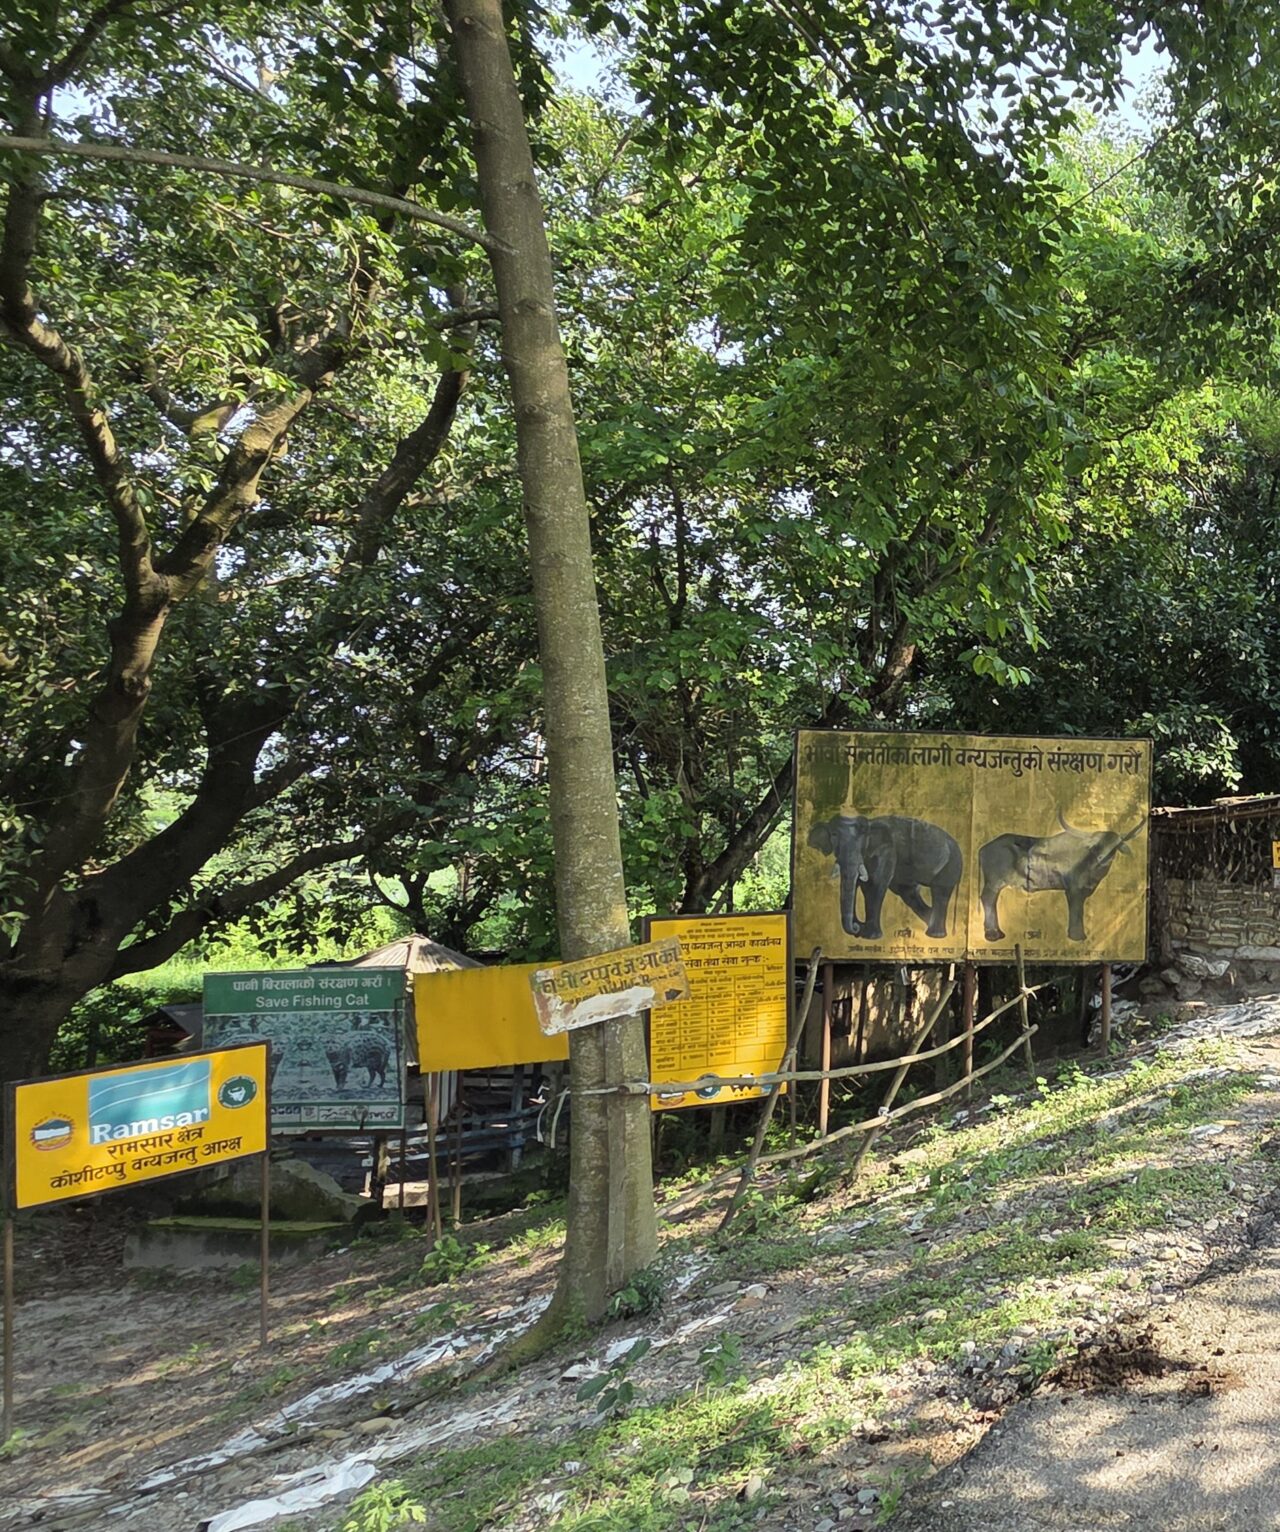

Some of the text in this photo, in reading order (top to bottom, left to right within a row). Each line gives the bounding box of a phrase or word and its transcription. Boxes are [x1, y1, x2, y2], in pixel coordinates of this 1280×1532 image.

[1047, 746, 1105, 773] संरक्षण
[233, 977, 258, 991] पानी
[318, 976, 358, 990] संरक्षण
[255, 993, 370, 1009] Save Fishing Cat
[91, 1106, 209, 1144] Ramsar
[106, 1126, 206, 1160] रामसार क्षेत्र
[50, 1136, 244, 1189] कोशीटप्पु वन्यजन्तु आरक्ष
